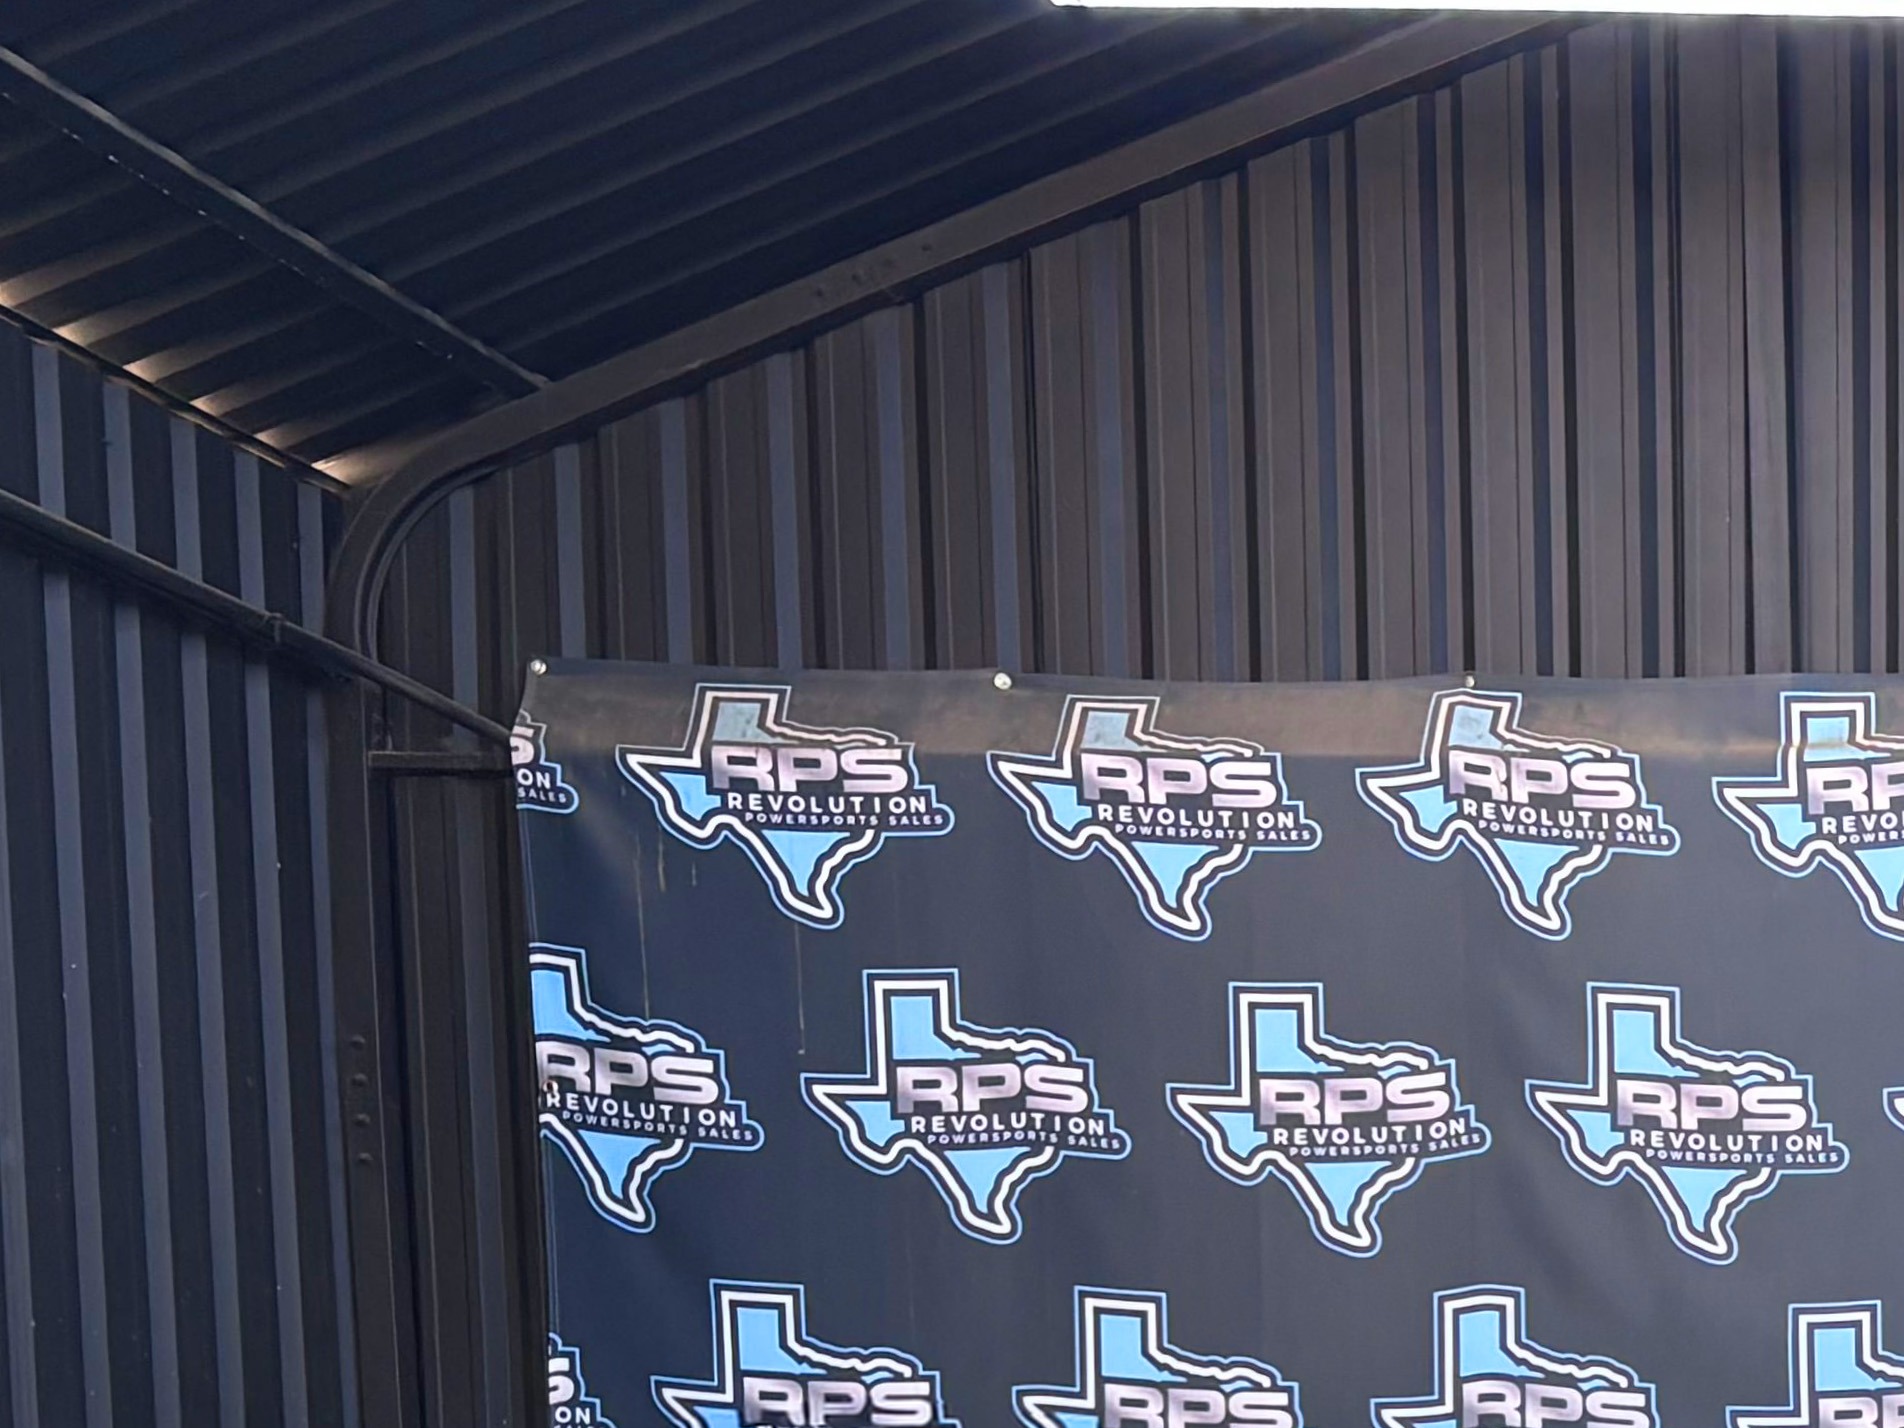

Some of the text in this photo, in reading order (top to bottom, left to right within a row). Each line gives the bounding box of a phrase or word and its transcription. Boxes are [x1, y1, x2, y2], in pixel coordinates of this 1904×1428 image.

[712, 746, 908, 792] RPS
[1081, 753, 1276, 807] RPS
[1449, 750, 1636, 808] RPS
[728, 792, 926, 814] REVOLUTION
[1098, 804, 1294, 828] REVOLUTION
[1463, 798, 1652, 832] REVOLUTION
[746, 812, 942, 825] POWERSPORTS SALES
[1115, 824, 1310, 840] POWERSPORTS SALES
[536, 1041, 718, 1104] RPS
[896, 1063, 1088, 1112] RPS
[1260, 1072, 1450, 1124] RPS
[1617, 1080, 1806, 1131] RPS
[912, 1112, 1104, 1136] REVOLUTION
[1274, 1118, 1465, 1145] REVOLUTION
[928, 1131, 1122, 1147] POWERSPORTS SALES
[1630, 1129, 1822, 1152] REVOLUTION
[1646, 1149, 1838, 1163] POWERSPORTS SALES
